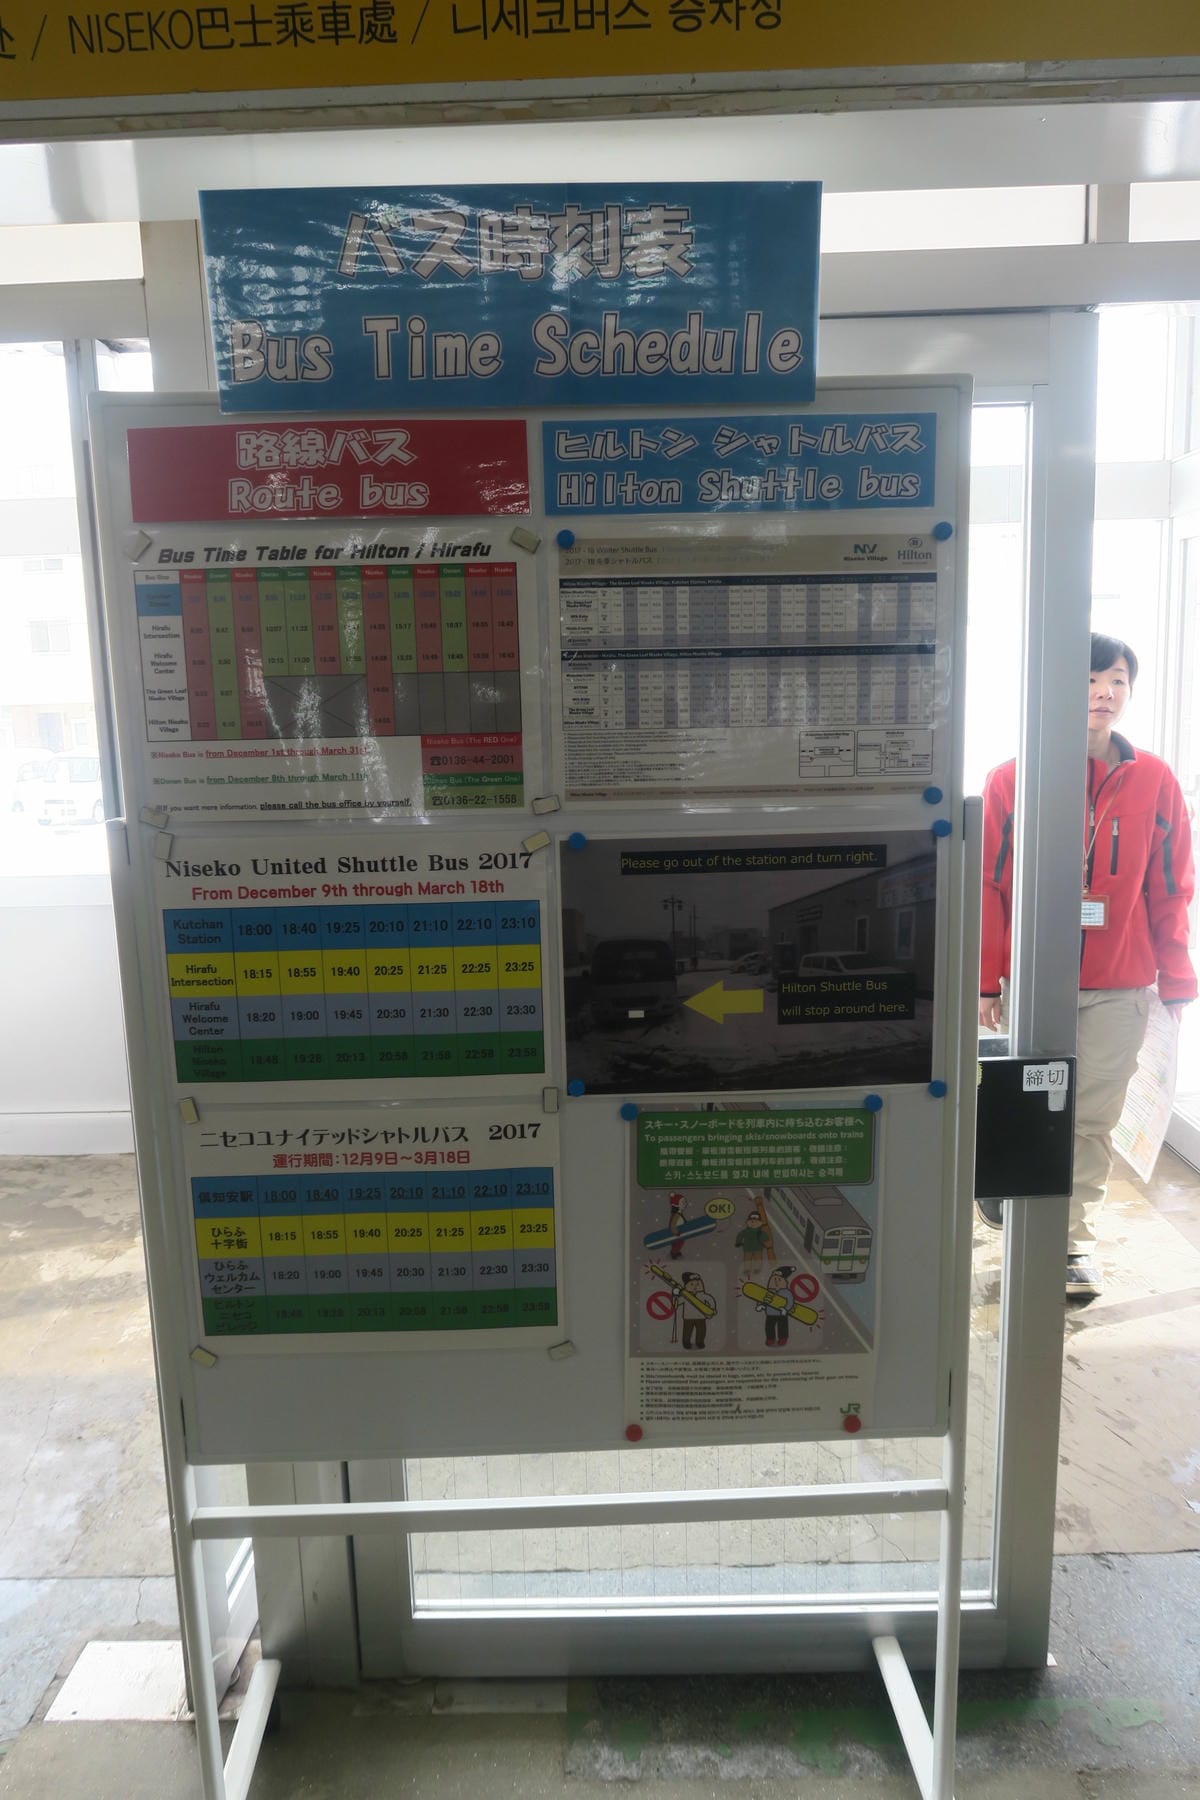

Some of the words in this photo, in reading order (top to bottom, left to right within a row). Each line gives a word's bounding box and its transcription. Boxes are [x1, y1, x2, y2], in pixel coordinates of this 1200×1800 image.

[336, 204, 695, 280] バス時刻表
[229, 318, 334, 383] Bus
[362, 314, 505, 382] Time
[532, 309, 804, 378] Schedule
[235, 429, 419, 470] 路線バス
[555, 427, 700, 461] ヒルトン
[713, 422, 927, 458] シャトルバス
[228, 475, 345, 514] Route
[359, 474, 431, 510] bus
[557, 469, 684, 508] Hilton
[696, 466, 843, 504] Shuttle
[857, 464, 921, 501] bus
[158, 547, 195, 564] Bus
[204, 547, 248, 563] Time
[255, 545, 308, 561] Table
[315, 544, 344, 560] for
[351, 543, 411, 559] Hilton
[431, 541, 493, 558] Hirafu
[897, 549, 933, 561] Hilton
[165, 860, 241, 879] Niseko
[250, 857, 327, 876] United
[337, 855, 418, 874] Shuttle
[428, 854, 469, 872] Bus
[478, 852, 533, 870] 2017
[621, 857, 660, 870] Please
[663, 860, 679, 872] go
[682, 857, 702, 868] out
[706, 855, 718, 867] of
[721, 854, 742, 866] the
[745, 853, 787, 866] station
[790, 851, 813, 864] and
[816, 851, 842, 864] turn
[845, 850, 878, 866] right.
[192, 887, 233, 901] From
[237, 885, 317, 900] December
[321, 884, 348, 897] 9th
[352, 882, 413, 898] through
[417, 881, 465, 895] March
[470, 880, 505, 894] 18th
[172, 919, 224, 931] Kutchan
[238, 923, 273, 936] 18:00
[282, 922, 317, 935] 18:40
[326, 921, 361, 934] 19:25
[369, 920, 405, 933] 20:10
[413, 919, 449, 932] 21:10
[457, 918, 493, 931] 22:10
[501, 916, 536, 930] 23:10
[177, 933, 222, 945] Station
[185, 964, 217, 975] Hirafu
[243, 968, 273, 979] 18:15
[287, 967, 317, 978] 18:55
[331, 966, 360, 977] 19:40
[374, 965, 404, 976] 20:25
[417, 964, 448, 975] 21:25
[461, 963, 492, 974] 22:25
[505, 961, 535, 972] 23:25
[171, 977, 234, 988] Intersection
[781, 983, 817, 994] Hilton
[820, 980, 863, 993] Shuttle
[865, 980, 888, 991] Bus
[189, 1001, 220, 1012] Hirafu
[246, 1012, 276, 1023] 18:20
[290, 1010, 320, 1021] 19:00
[333, 1009, 363, 1020] 19:45
[376, 1008, 406, 1019] 20:30
[420, 1007, 450, 1018] 21:30
[463, 1006, 493, 1017] 22:30
[506, 1004, 537, 1016] 23:30
[781, 1005, 801, 1017] will
[804, 1004, 831, 1018] stop
[833, 1003, 876, 1015] around
[878, 1002, 910, 1014] here.
[182, 1013, 229, 1024] Welcome
[188, 1026, 225, 1036] Center
[1025, 1069, 1065, 1087] 締切
[488, 1123, 541, 1141] 2017
[644, 1134, 656, 1142] To
[657, 1134, 706, 1144] passengers
[707, 1132, 743, 1143] bringing
[264, 1190, 297, 1202] 18:00
[306, 1188, 340, 1201] 18:40
[349, 1187, 381, 1200] 19:25
[390, 1186, 424, 1199] 20:10
[432, 1185, 466, 1198] 21:10
[473, 1184, 508, 1196] 22:10
[516, 1183, 550, 1195] 23:10
[708, 1203, 731, 1214] OK!
[210, 1227, 247, 1238] ひらふ
[269, 1231, 297, 1242] 18:15
[311, 1230, 339, 1240] 18:55
[353, 1228, 381, 1239] 19:40
[394, 1227, 423, 1238] 20:25
[435, 1226, 465, 1237] 21:25
[477, 1225, 506, 1235] 22:25
[520, 1223, 548, 1234] 23:25
[211, 1238, 248, 1250] 十字街
[213, 1260, 249, 1271] ひらふ
[272, 1270, 300, 1281] 18:20
[314, 1269, 342, 1280] 19:00
[356, 1268, 383, 1278] 19:45
[396, 1266, 425, 1277] 20:30
[438, 1265, 466, 1277] 21:30
[479, 1264, 508, 1275] 22:30
[521, 1262, 550, 1273] 23:30
[211, 1284, 257, 1294] センター
[839, 1402, 862, 1414] JR
